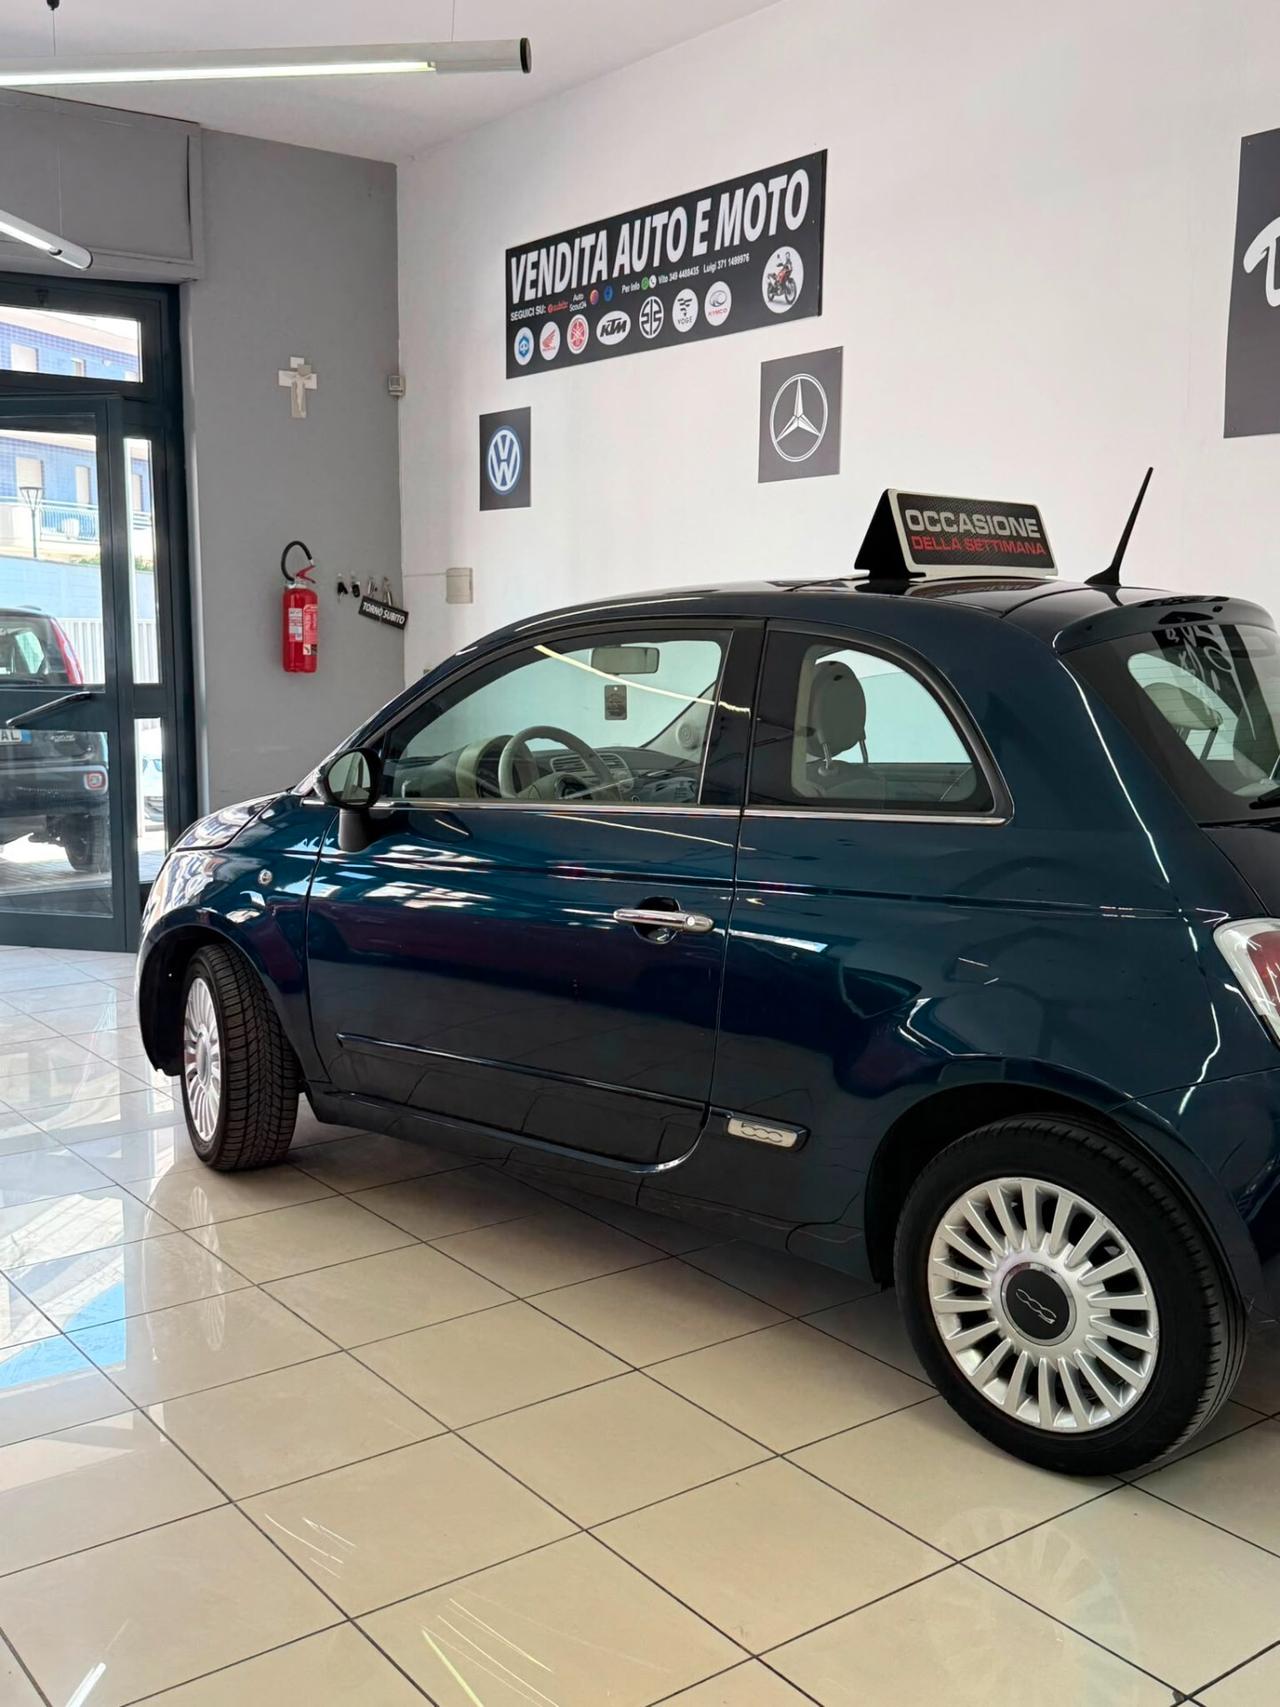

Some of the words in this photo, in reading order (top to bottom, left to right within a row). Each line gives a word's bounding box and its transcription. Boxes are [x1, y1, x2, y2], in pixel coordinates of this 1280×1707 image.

[511, 230, 608, 304] VENDITA
[612, 206, 687, 277] AUTO
[692, 198, 711, 256] E
[714, 168, 809, 251] MOTO
[703, 261, 716, 273] Luigi
[717, 258, 727, 270] 371
[510, 306, 535, 322] SEGUICI
[599, 317, 628, 338] KTM
[905, 509, 1041, 538] OCCASIONE
[911, 536, 960, 551] DELLA
[964, 537, 1047, 555] SETTIMANA
[362, 602, 383, 616] TORNO
[383, 610, 405, 624] SUBITO
